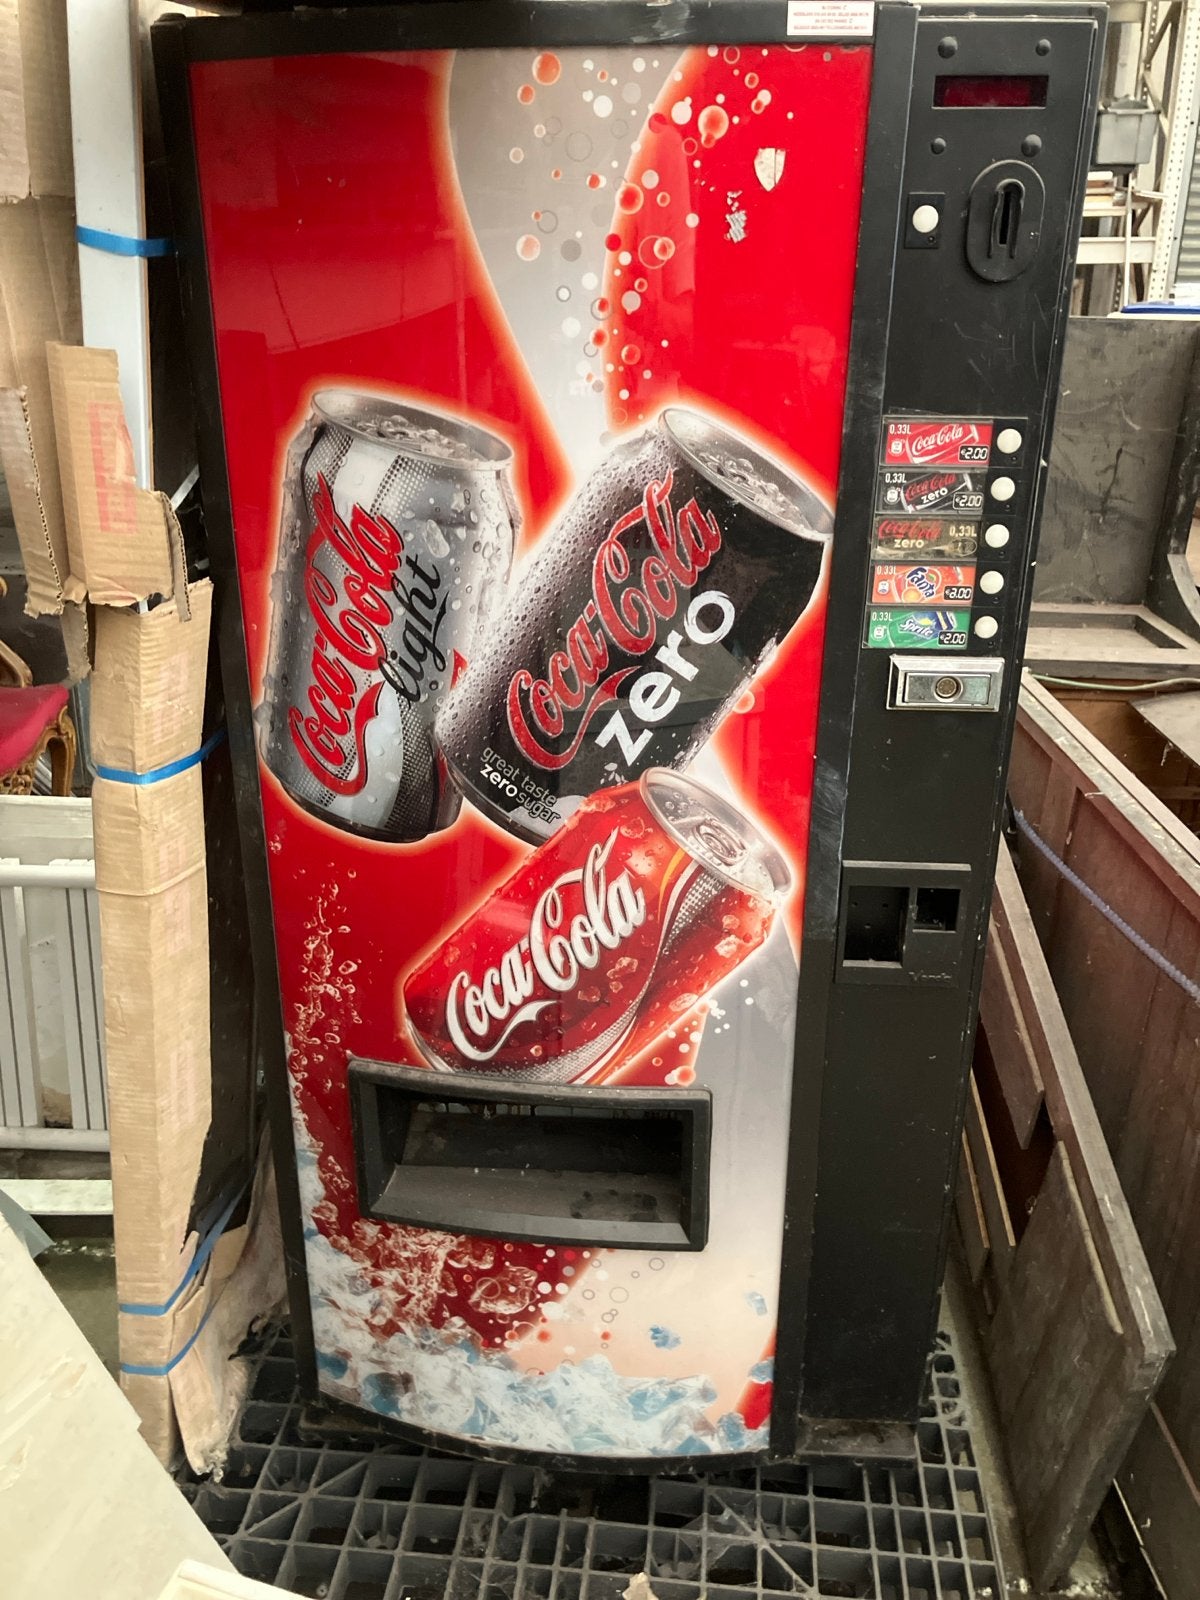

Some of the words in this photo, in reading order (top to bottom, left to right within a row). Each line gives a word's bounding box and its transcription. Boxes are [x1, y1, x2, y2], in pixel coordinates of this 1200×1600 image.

[889, 424, 911, 435] 0.33L
[885, 473, 907, 484] 0.33L
[920, 487, 949, 504] zero
[894, 538, 925, 548] zero
[906, 566, 937, 599] Fanta
[288, 470, 405, 796] Coca-Cola
[378, 553, 450, 710] light
[507, 467, 722, 770] Coca-Cola
[872, 612, 893, 622] 0.33L
[900, 618, 934, 637] Sprite
[594, 590, 735, 767] zero
[480, 747, 520, 781] great
[520, 775, 557, 807] taste
[480, 763, 518, 797] zero
[516, 792, 562, 824] sugar
[446, 826, 647, 1062] Coca-Cola
